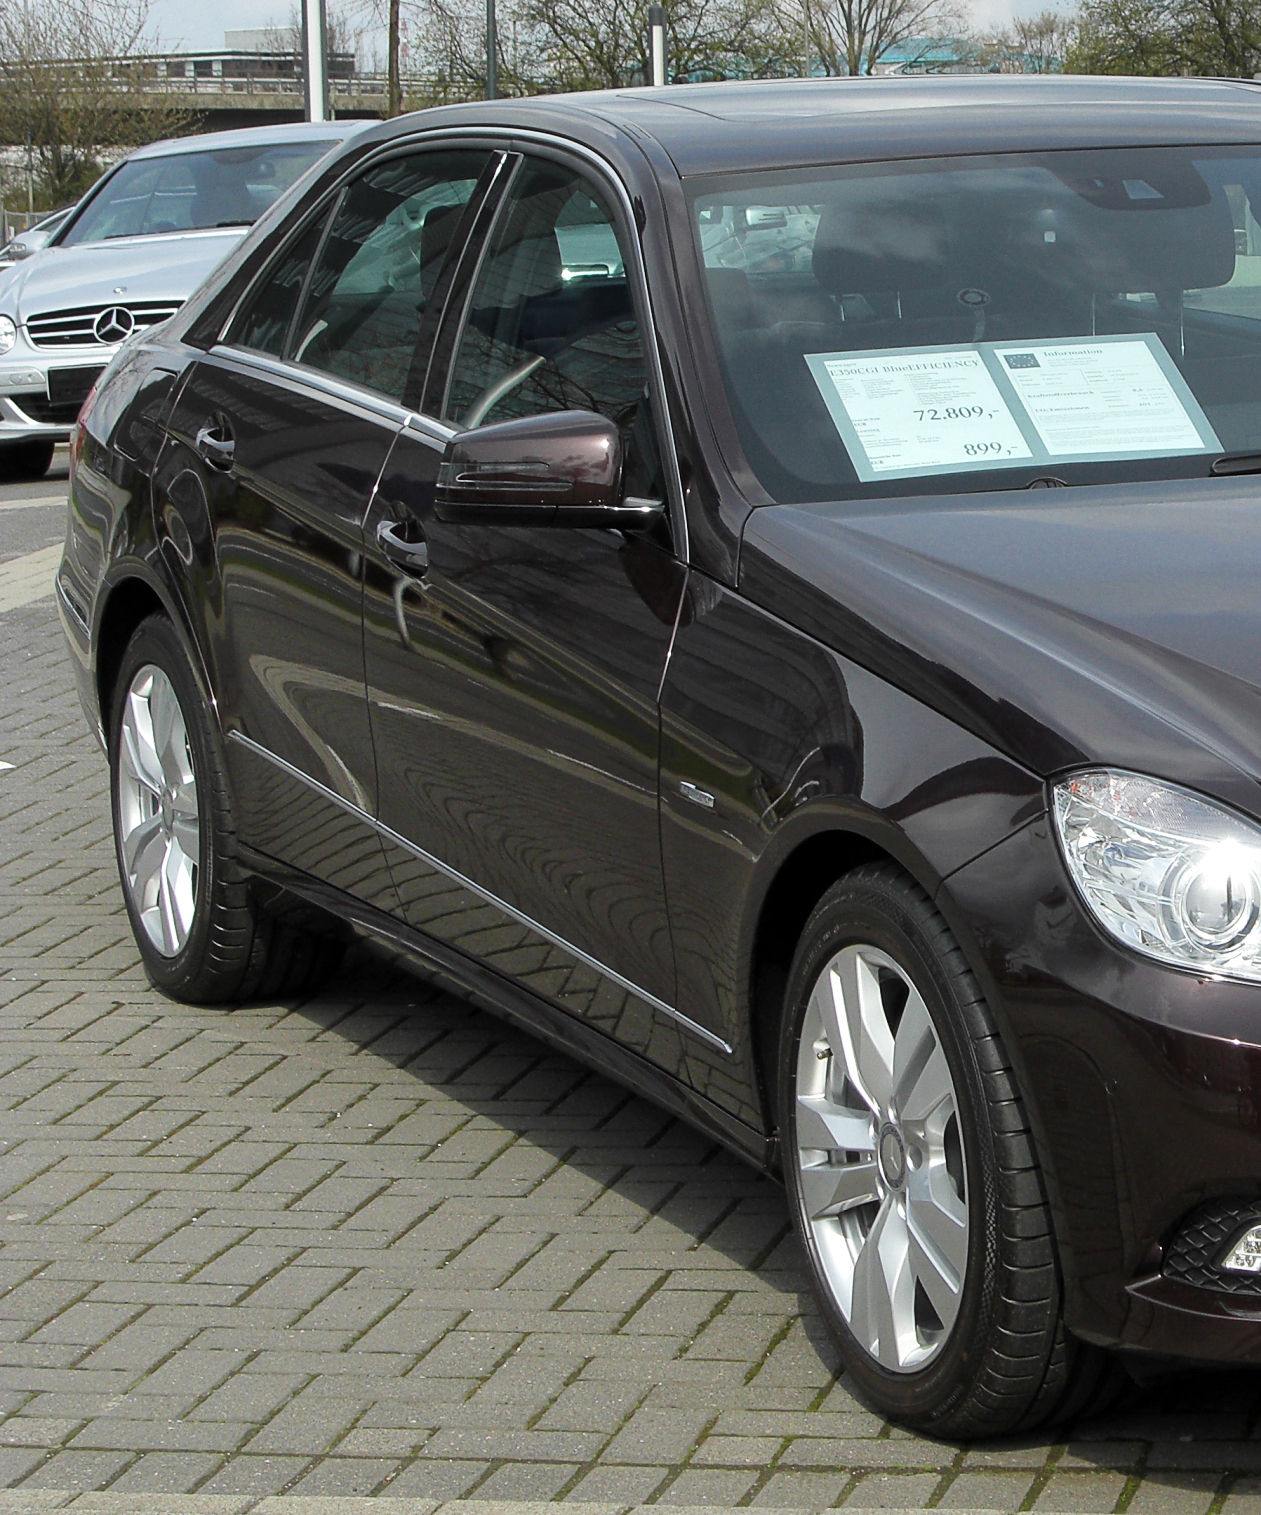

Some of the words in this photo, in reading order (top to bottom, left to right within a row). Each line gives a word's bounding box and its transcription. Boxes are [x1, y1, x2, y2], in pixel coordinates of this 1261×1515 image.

[829, 367, 879, 376] E350CGI
[883, 360, 979, 373] BlueEFFICIENCY
[913, 405, 1000, 422] 72.809,-
[963, 441, 1018, 456] 899,-
